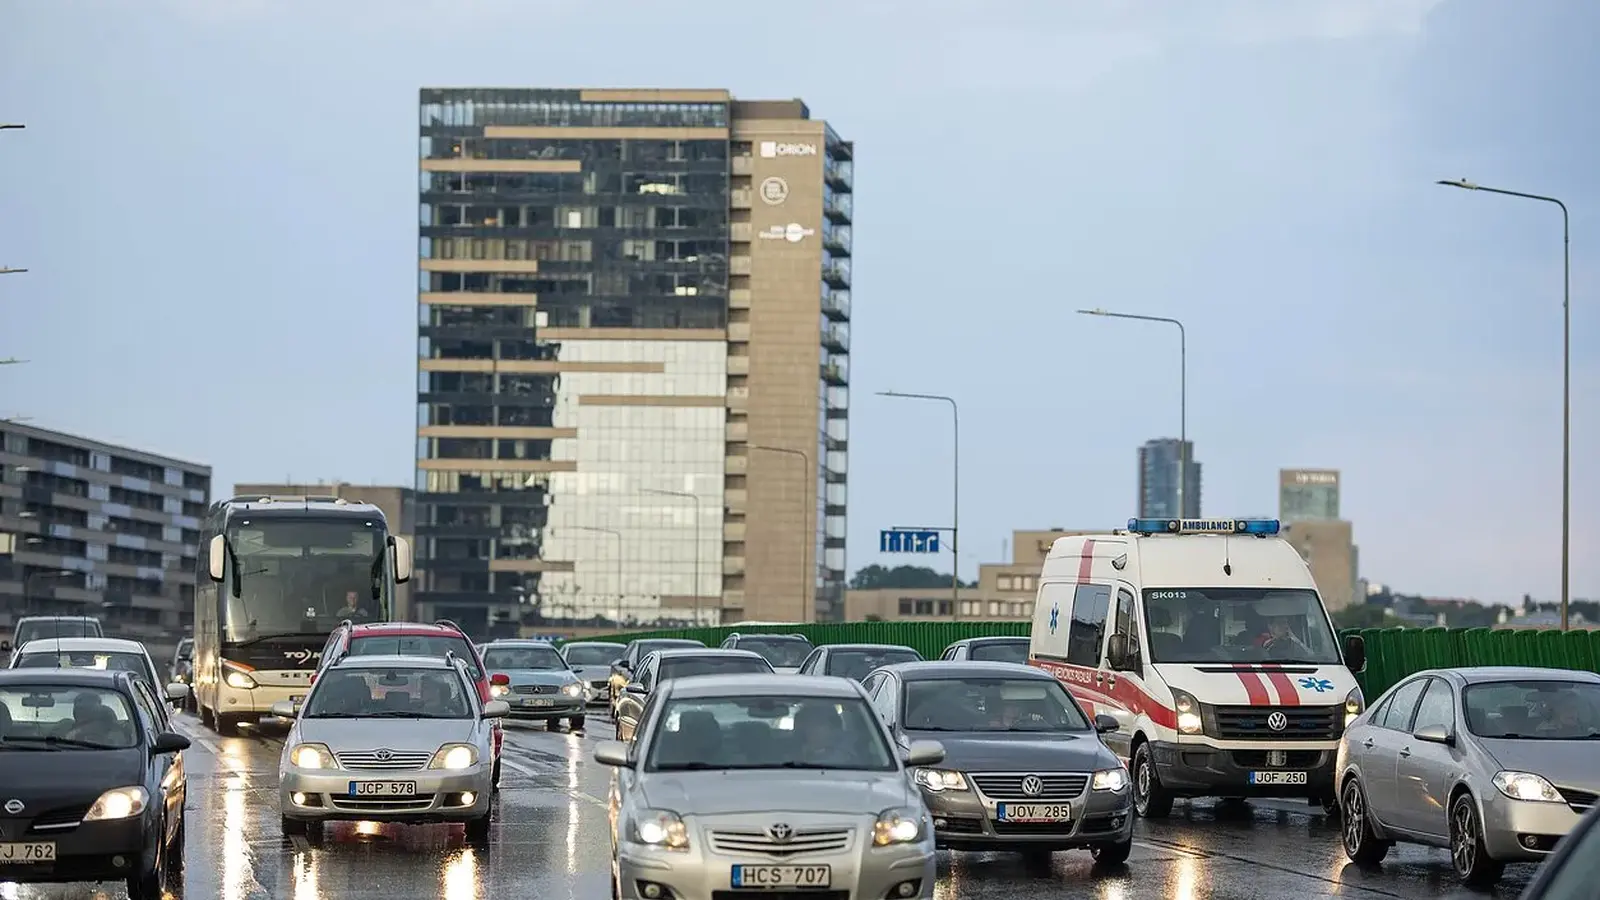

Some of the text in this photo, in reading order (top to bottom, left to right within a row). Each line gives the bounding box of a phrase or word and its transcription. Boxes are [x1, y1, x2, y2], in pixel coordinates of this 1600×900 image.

[777, 143, 816, 156] ORION
[1182, 520, 1234, 531] AMBULANCE
[1151, 591, 1187, 600] SK013
[284, 651, 322, 659] TOK
[1256, 772, 1306, 783] JOF 250
[357, 783, 414, 794] JCP 578
[1007, 806, 1068, 818] JOV 285
[0, 844, 53, 859] J 762
[743, 868, 827, 883] HCS 707
